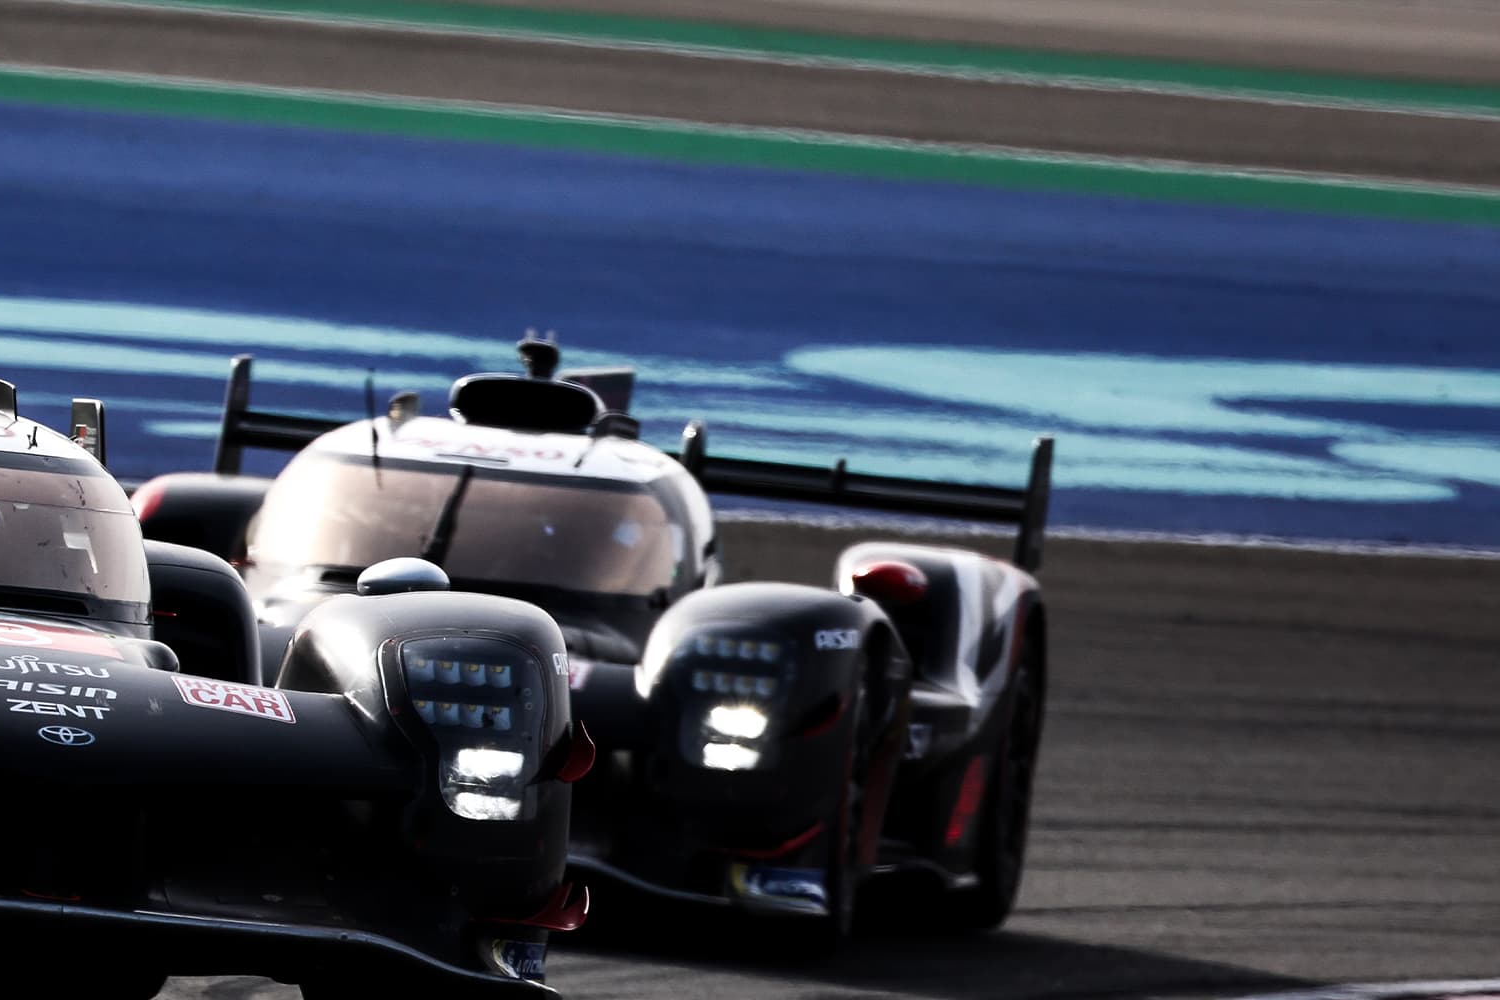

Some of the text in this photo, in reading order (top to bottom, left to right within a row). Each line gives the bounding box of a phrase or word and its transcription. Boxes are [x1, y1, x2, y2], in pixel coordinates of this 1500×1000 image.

[184, 680, 277, 701] HYPER
[6, 698, 111, 719] ZENT
[190, 688, 285, 718] CAR
